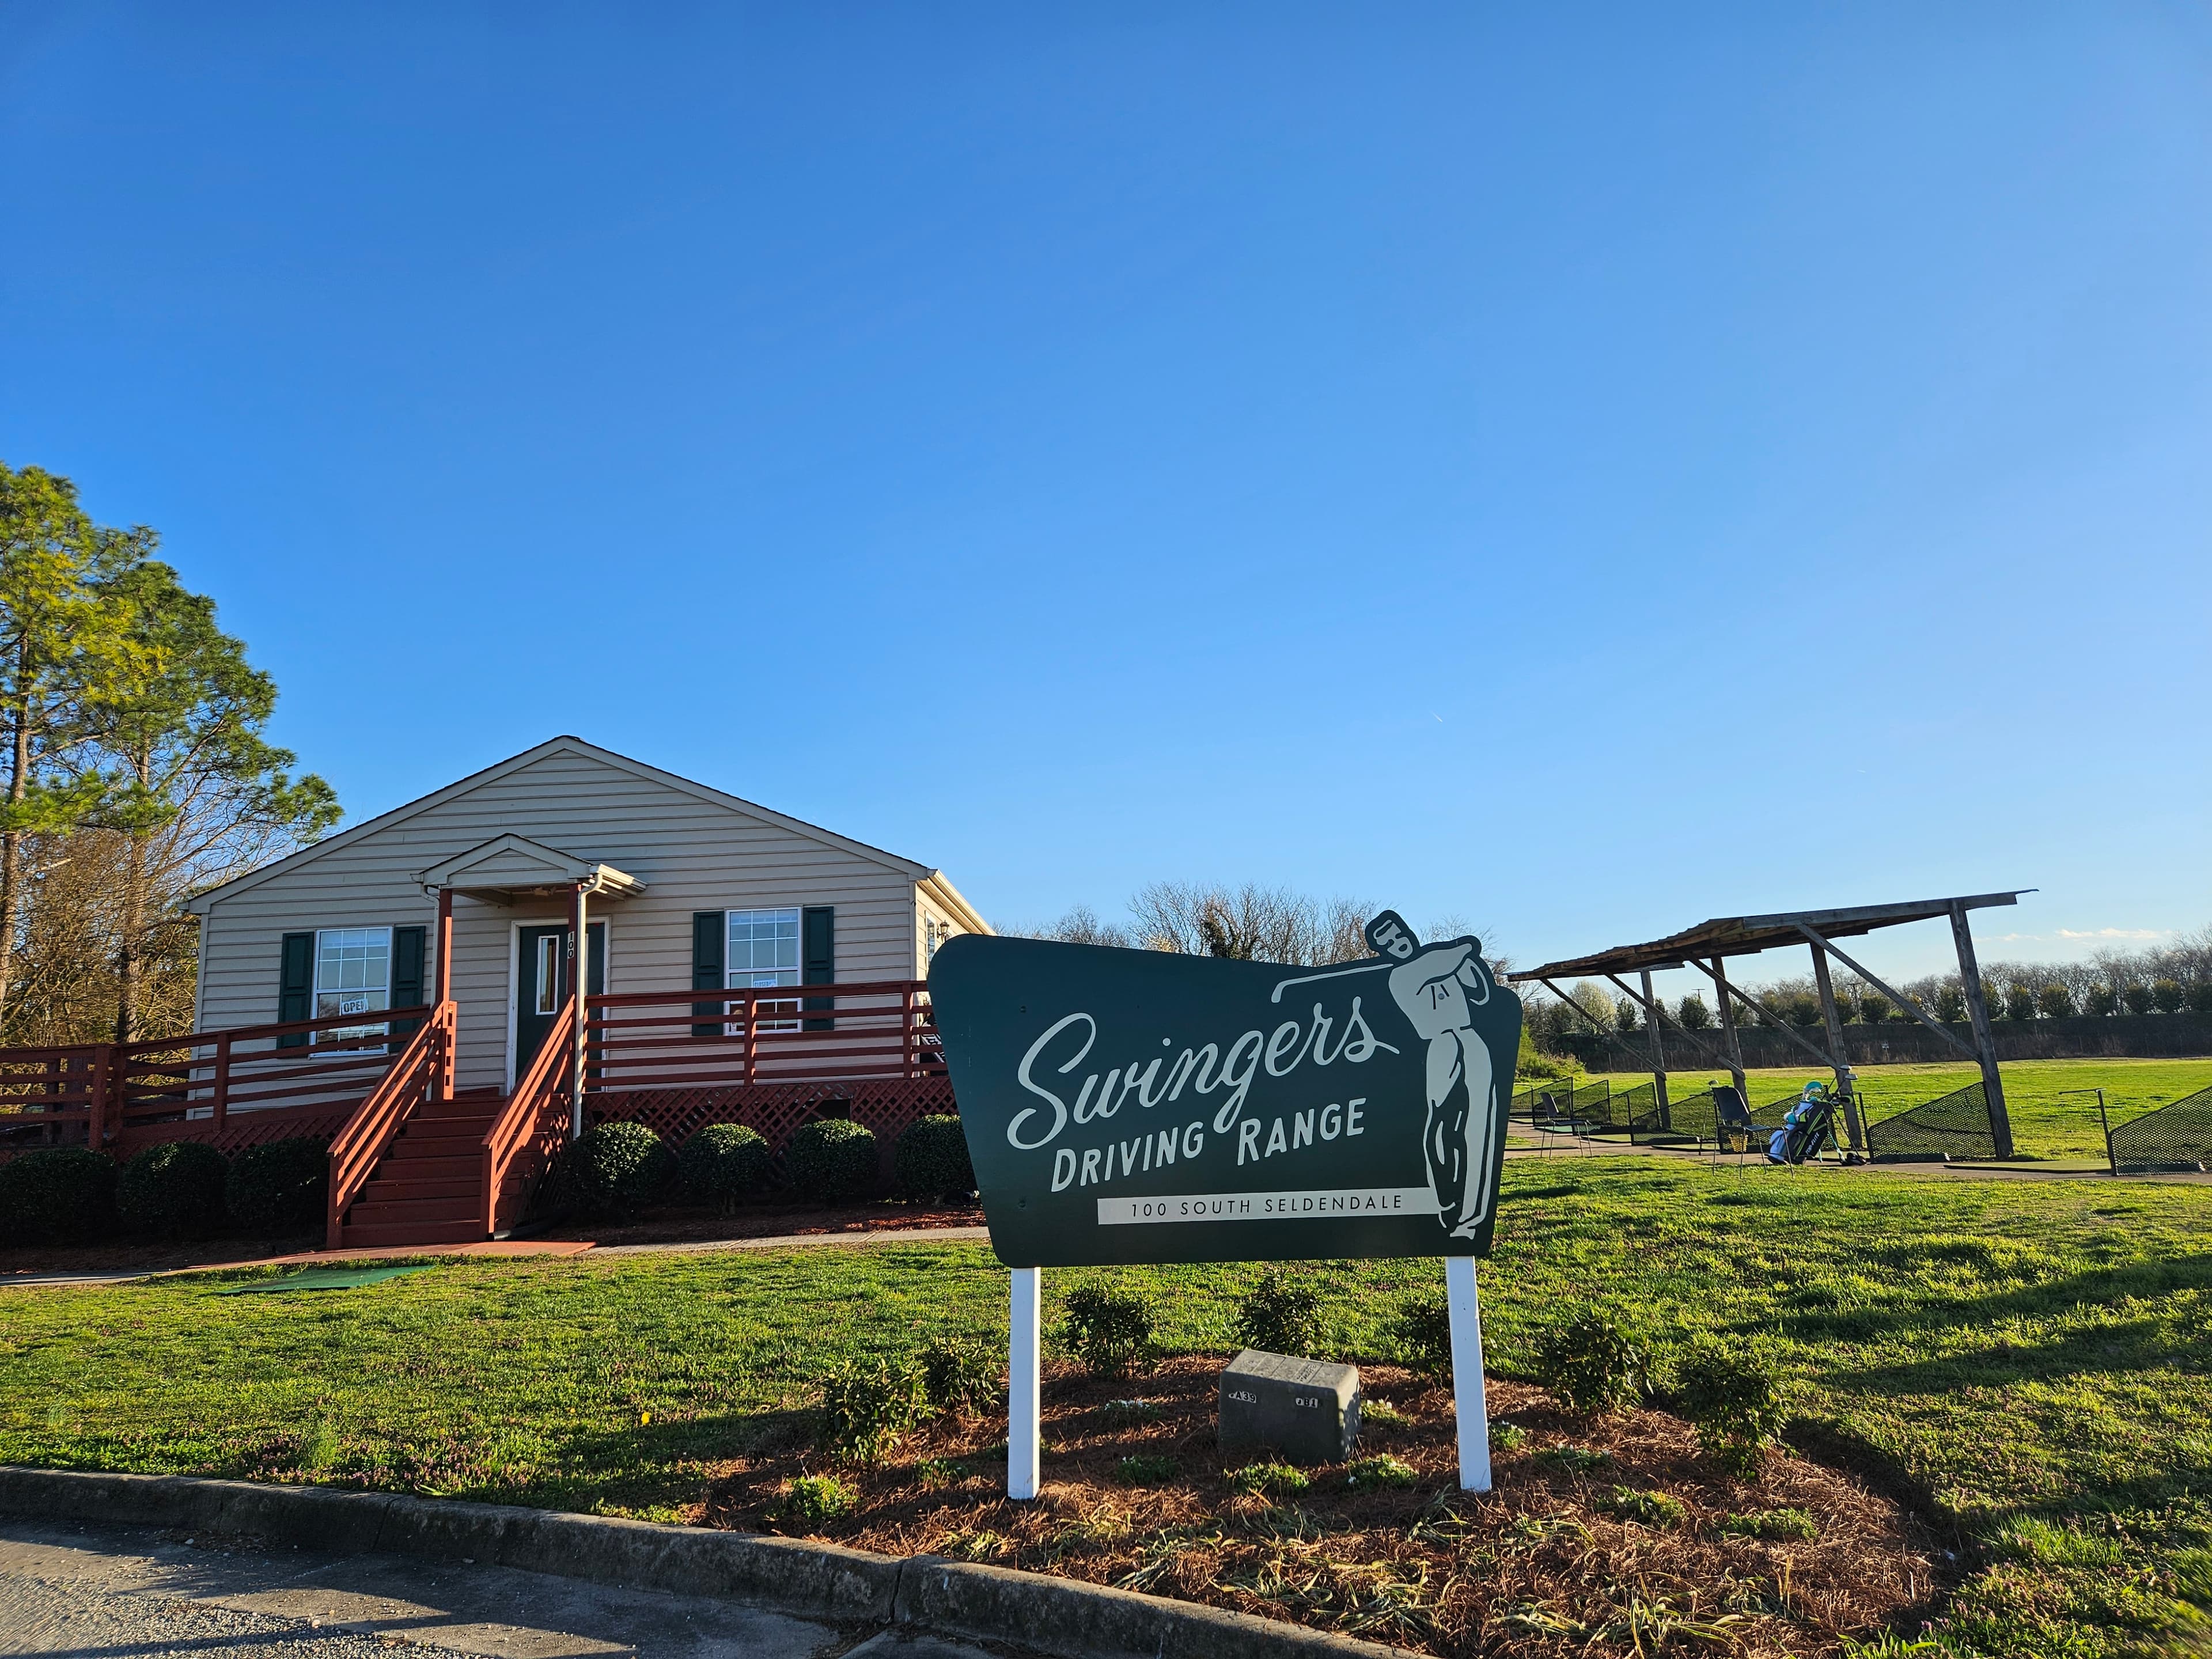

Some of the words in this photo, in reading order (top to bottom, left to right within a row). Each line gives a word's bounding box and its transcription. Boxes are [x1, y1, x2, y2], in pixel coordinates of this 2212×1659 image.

[343, 999, 367, 1013] OPEN
[1007, 996, 1400, 1150] Swingers
[1051, 1118, 1203, 1192] DRIVING
[1237, 1098, 1366, 1166] RANGE
[1132, 1203, 1166, 1217] 100
[1181, 1199, 1250, 1215] SOUTH
[1264, 1195, 1402, 1213] SELDENDALE
